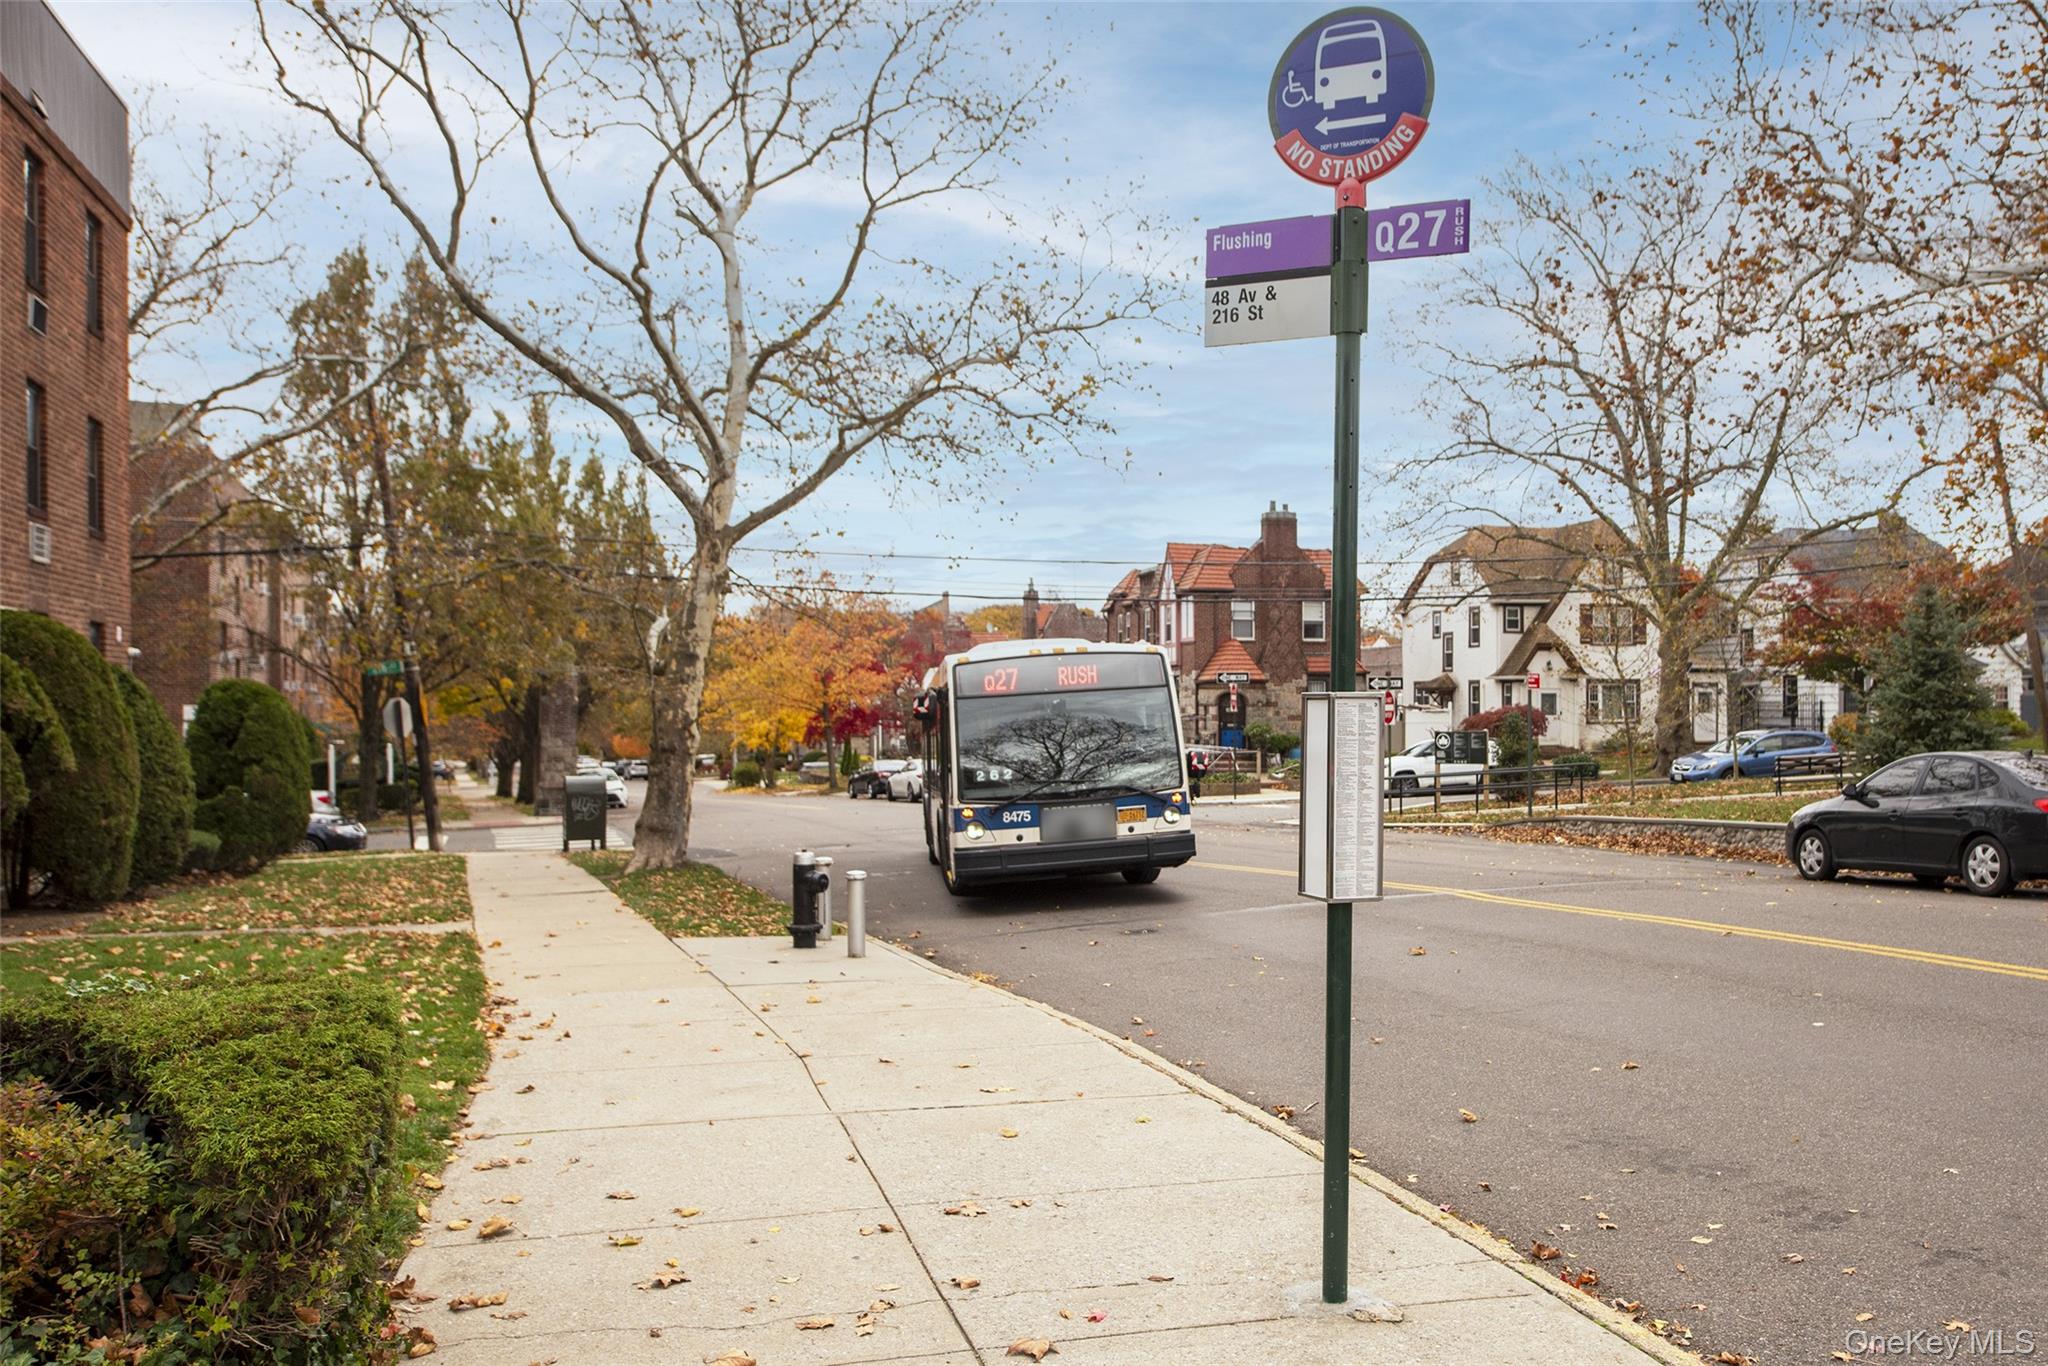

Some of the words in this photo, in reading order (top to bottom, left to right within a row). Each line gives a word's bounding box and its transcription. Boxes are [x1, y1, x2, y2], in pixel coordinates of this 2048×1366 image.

[1286, 140, 1315, 170] NO
[1319, 124, 1416, 179] STANDING
[1320, 142, 1332, 151] DEPT
[1340, 138, 1380, 149] TRANSPORTATION
[1375, 209, 1447, 254] Q27
[1454, 206, 1465, 246] RUSH
[1213, 230, 1273, 252] Flushing
[1211, 290, 1230, 306] 48
[1238, 288, 1257, 304] Av
[1265, 285, 1277, 301] &
[1212, 307, 1240, 325] 216
[1248, 304, 1264, 321] St
[984, 667, 1019, 691] Q27
[1057, 664, 1099, 686] RUSH
[1002, 810, 1032, 823] 8475
